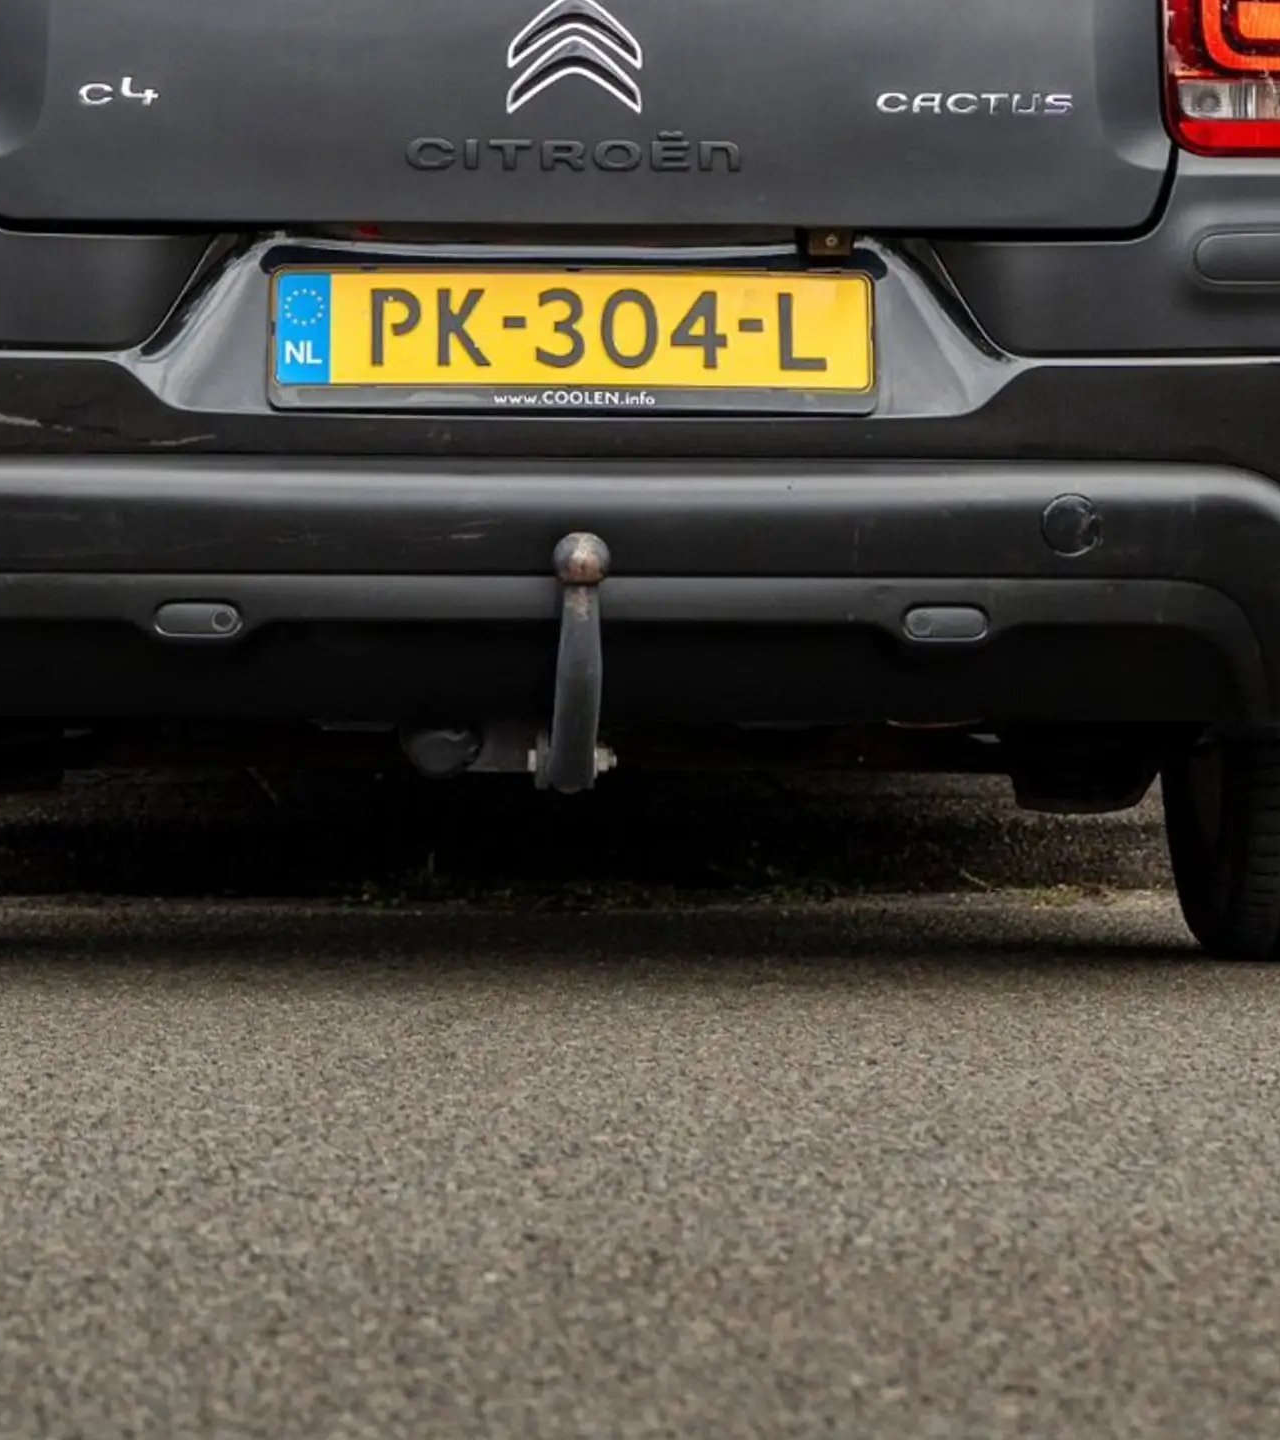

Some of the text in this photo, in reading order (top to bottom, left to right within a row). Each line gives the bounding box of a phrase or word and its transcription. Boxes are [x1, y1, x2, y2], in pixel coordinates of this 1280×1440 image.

[77, 76, 161, 107] C4
[875, 91, 1075, 116] CACTUS
[369, 287, 829, 372] PK-304-L
[284, 341, 322, 365] NL
[492, 389, 657, 407] www.COOLEN.info
